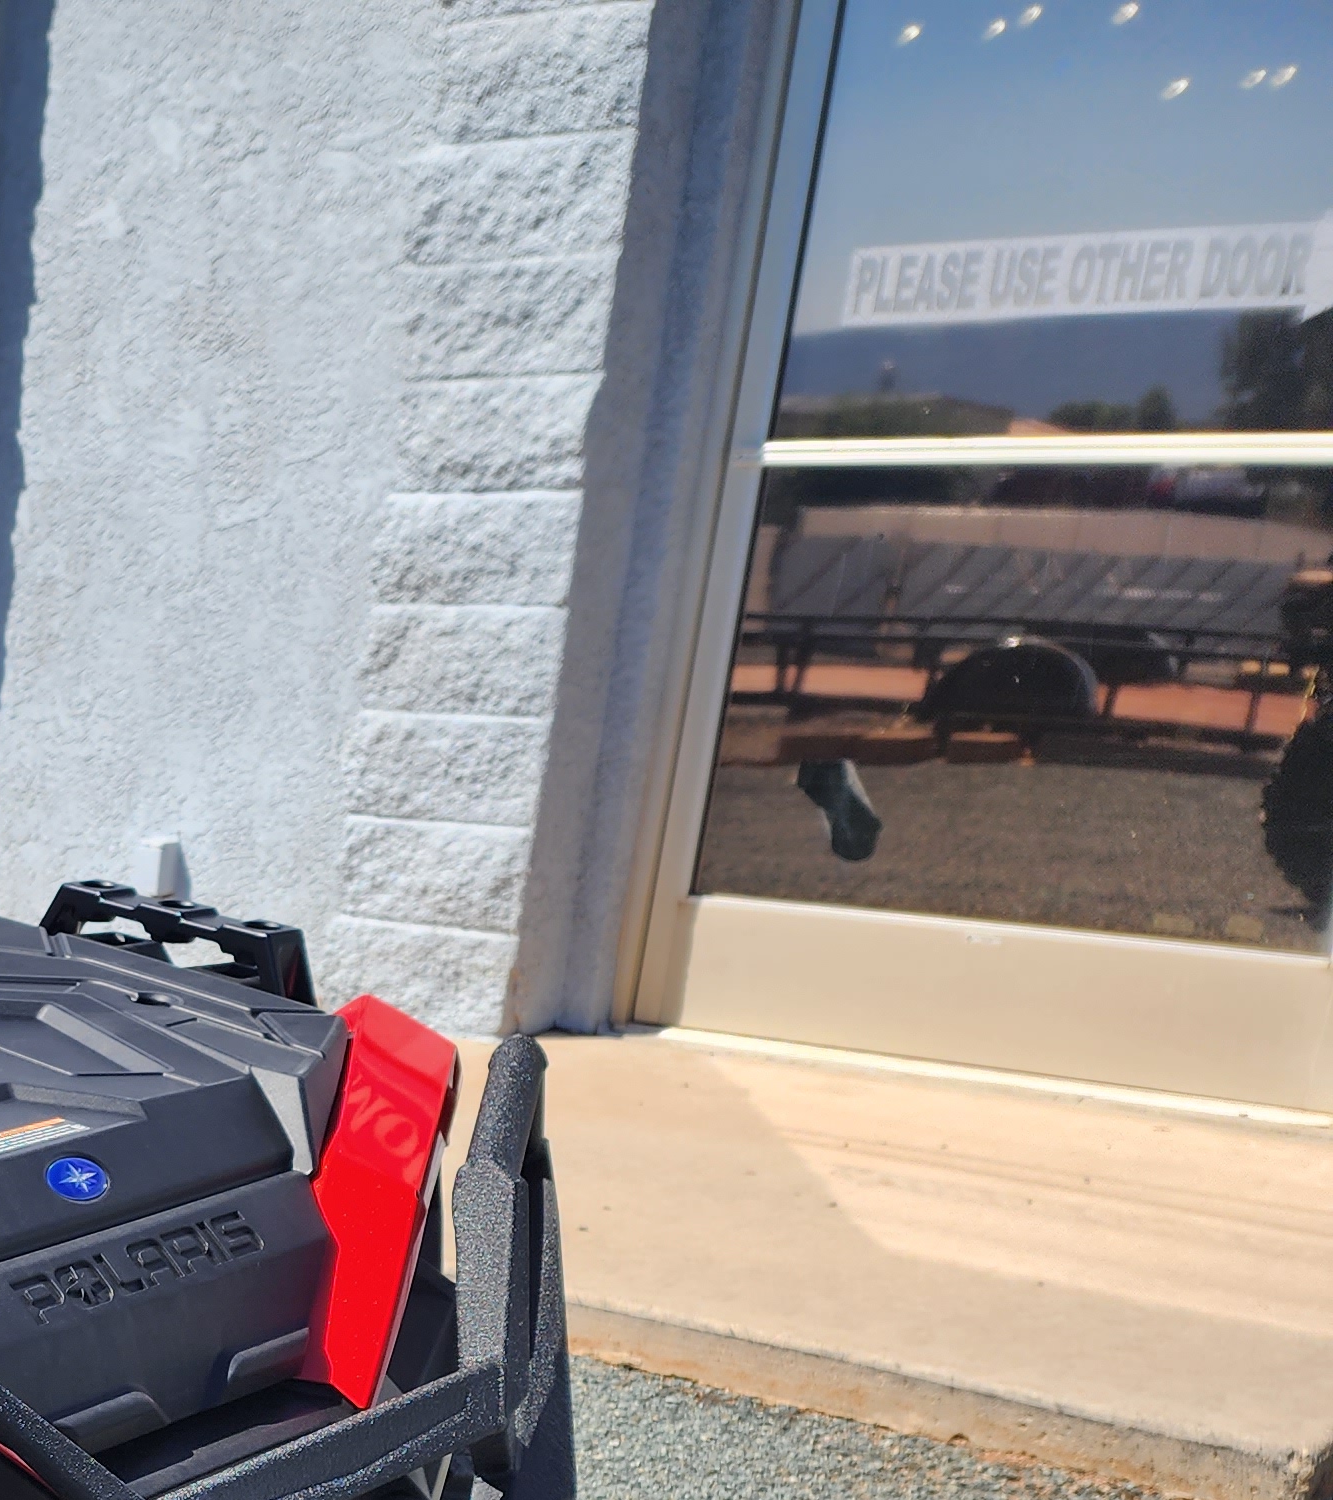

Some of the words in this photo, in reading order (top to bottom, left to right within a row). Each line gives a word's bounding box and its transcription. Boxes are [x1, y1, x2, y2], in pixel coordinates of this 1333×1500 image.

[853, 249, 985, 314] PLEASE
[989, 245, 1064, 302] USE
[1068, 239, 1195, 300] OTHER
[1200, 231, 1314, 297] DOOR
[9, 1209, 265, 1327] POLARIS
